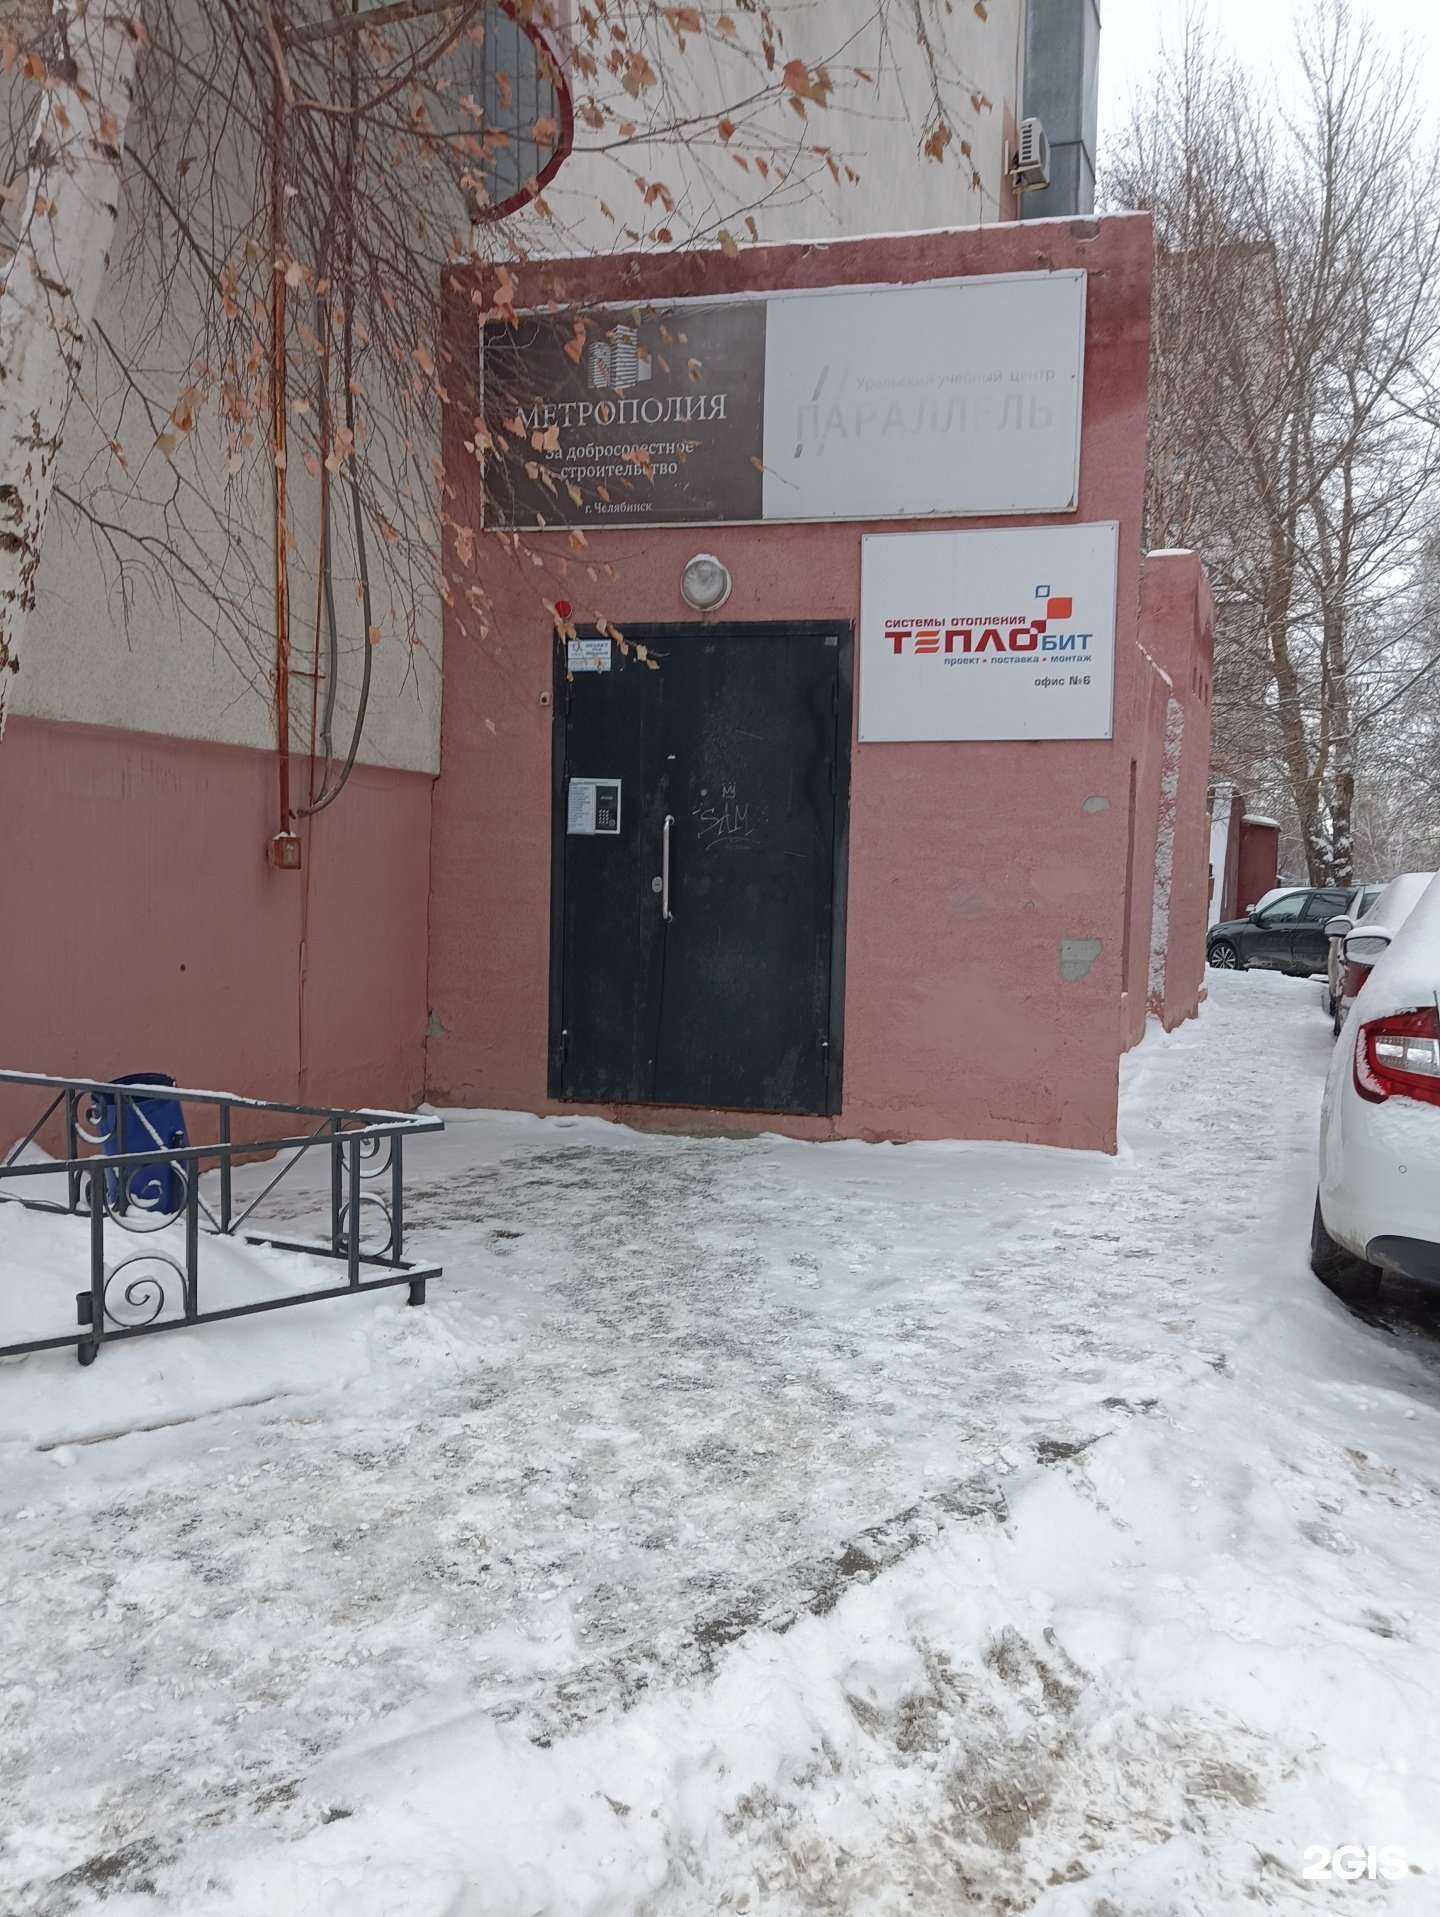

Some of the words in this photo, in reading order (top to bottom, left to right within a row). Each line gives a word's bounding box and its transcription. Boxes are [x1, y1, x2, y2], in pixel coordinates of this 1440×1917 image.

[517, 393, 727, 430] МЕТРОПОЛИЯ
[797, 392, 1056, 440] ПАРАЛЛЕЛЬ
[585, 504, 592, 514] г.
[594, 501, 653, 514] Челябинск
[885, 617, 945, 628] системы
[951, 615, 1026, 627] отопления
[944, 656, 980, 667] проект
[990, 655, 1040, 665] поставка
[1050, 654, 1093, 663] монтаж
[1034, 675, 1065, 688] офис
